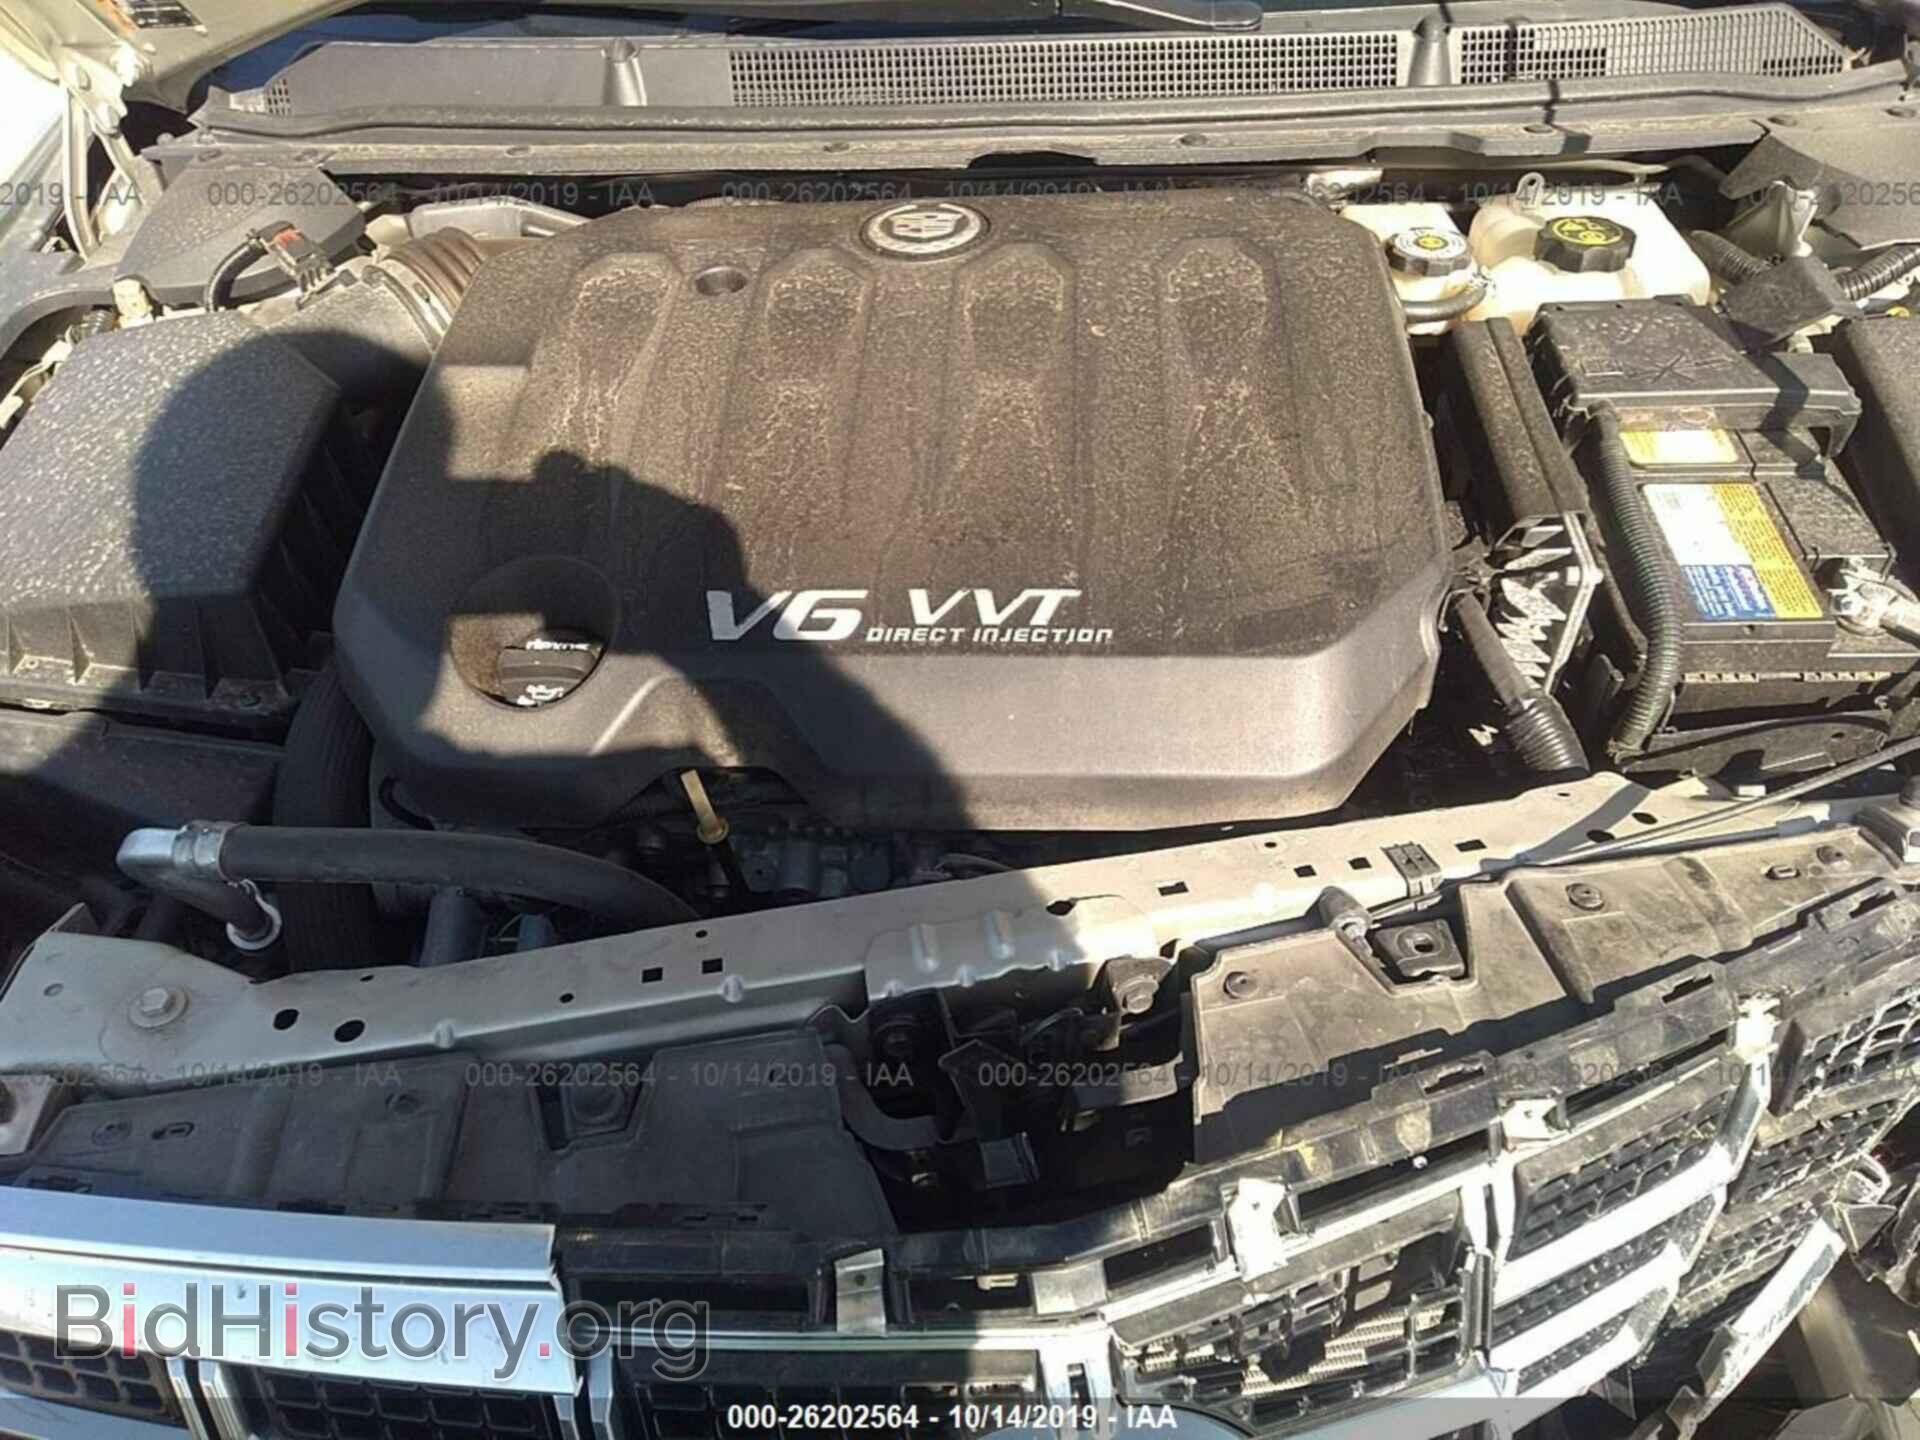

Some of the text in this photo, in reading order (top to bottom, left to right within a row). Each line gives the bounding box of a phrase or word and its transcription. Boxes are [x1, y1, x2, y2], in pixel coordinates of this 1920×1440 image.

[705, 589, 1082, 640] V6 VVT
[866, 628, 964, 642] DIRECT
